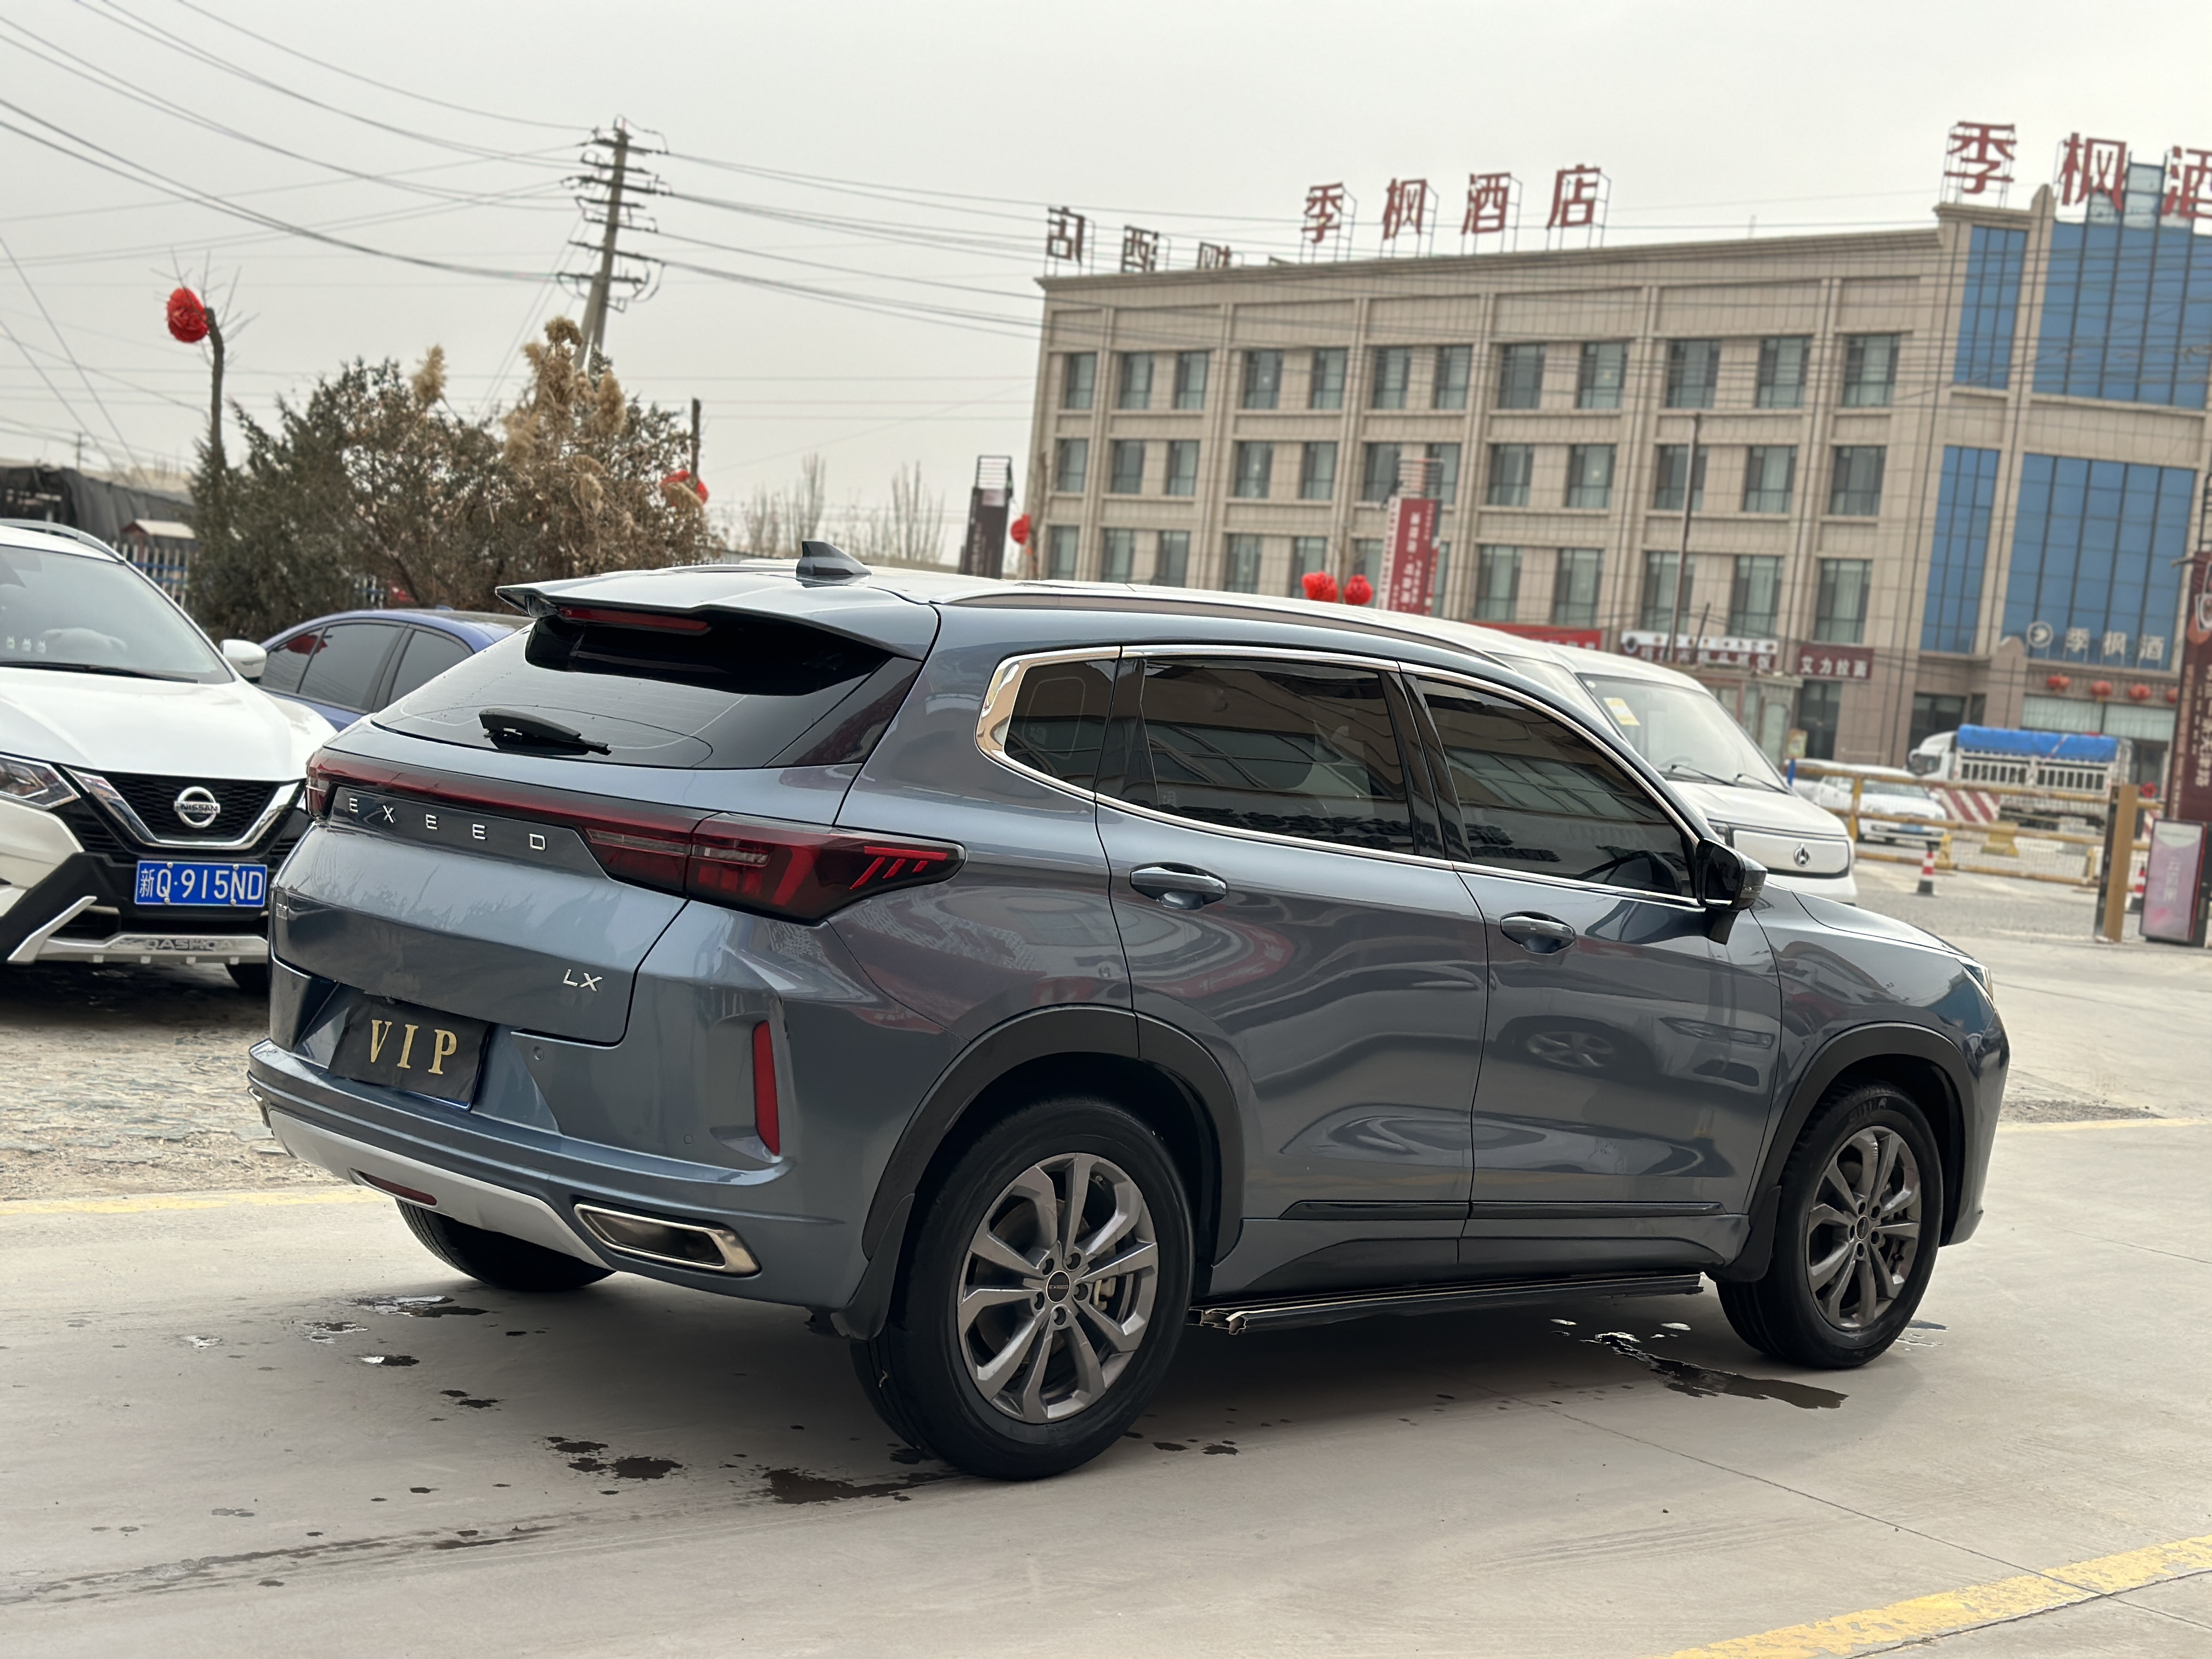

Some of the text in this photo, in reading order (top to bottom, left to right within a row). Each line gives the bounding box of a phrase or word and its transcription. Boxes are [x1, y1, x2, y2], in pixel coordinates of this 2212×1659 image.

[1301, 163, 1601, 244] 季枫酒店
[2065, 627, 2165, 661] 季枫酒
[180, 804, 218, 812] NISSAN
[348, 798, 546, 851] EXEED
[144, 938, 239, 951] QASHQA
[562, 969, 603, 991] LX
[369, 1019, 458, 1075] VIP
